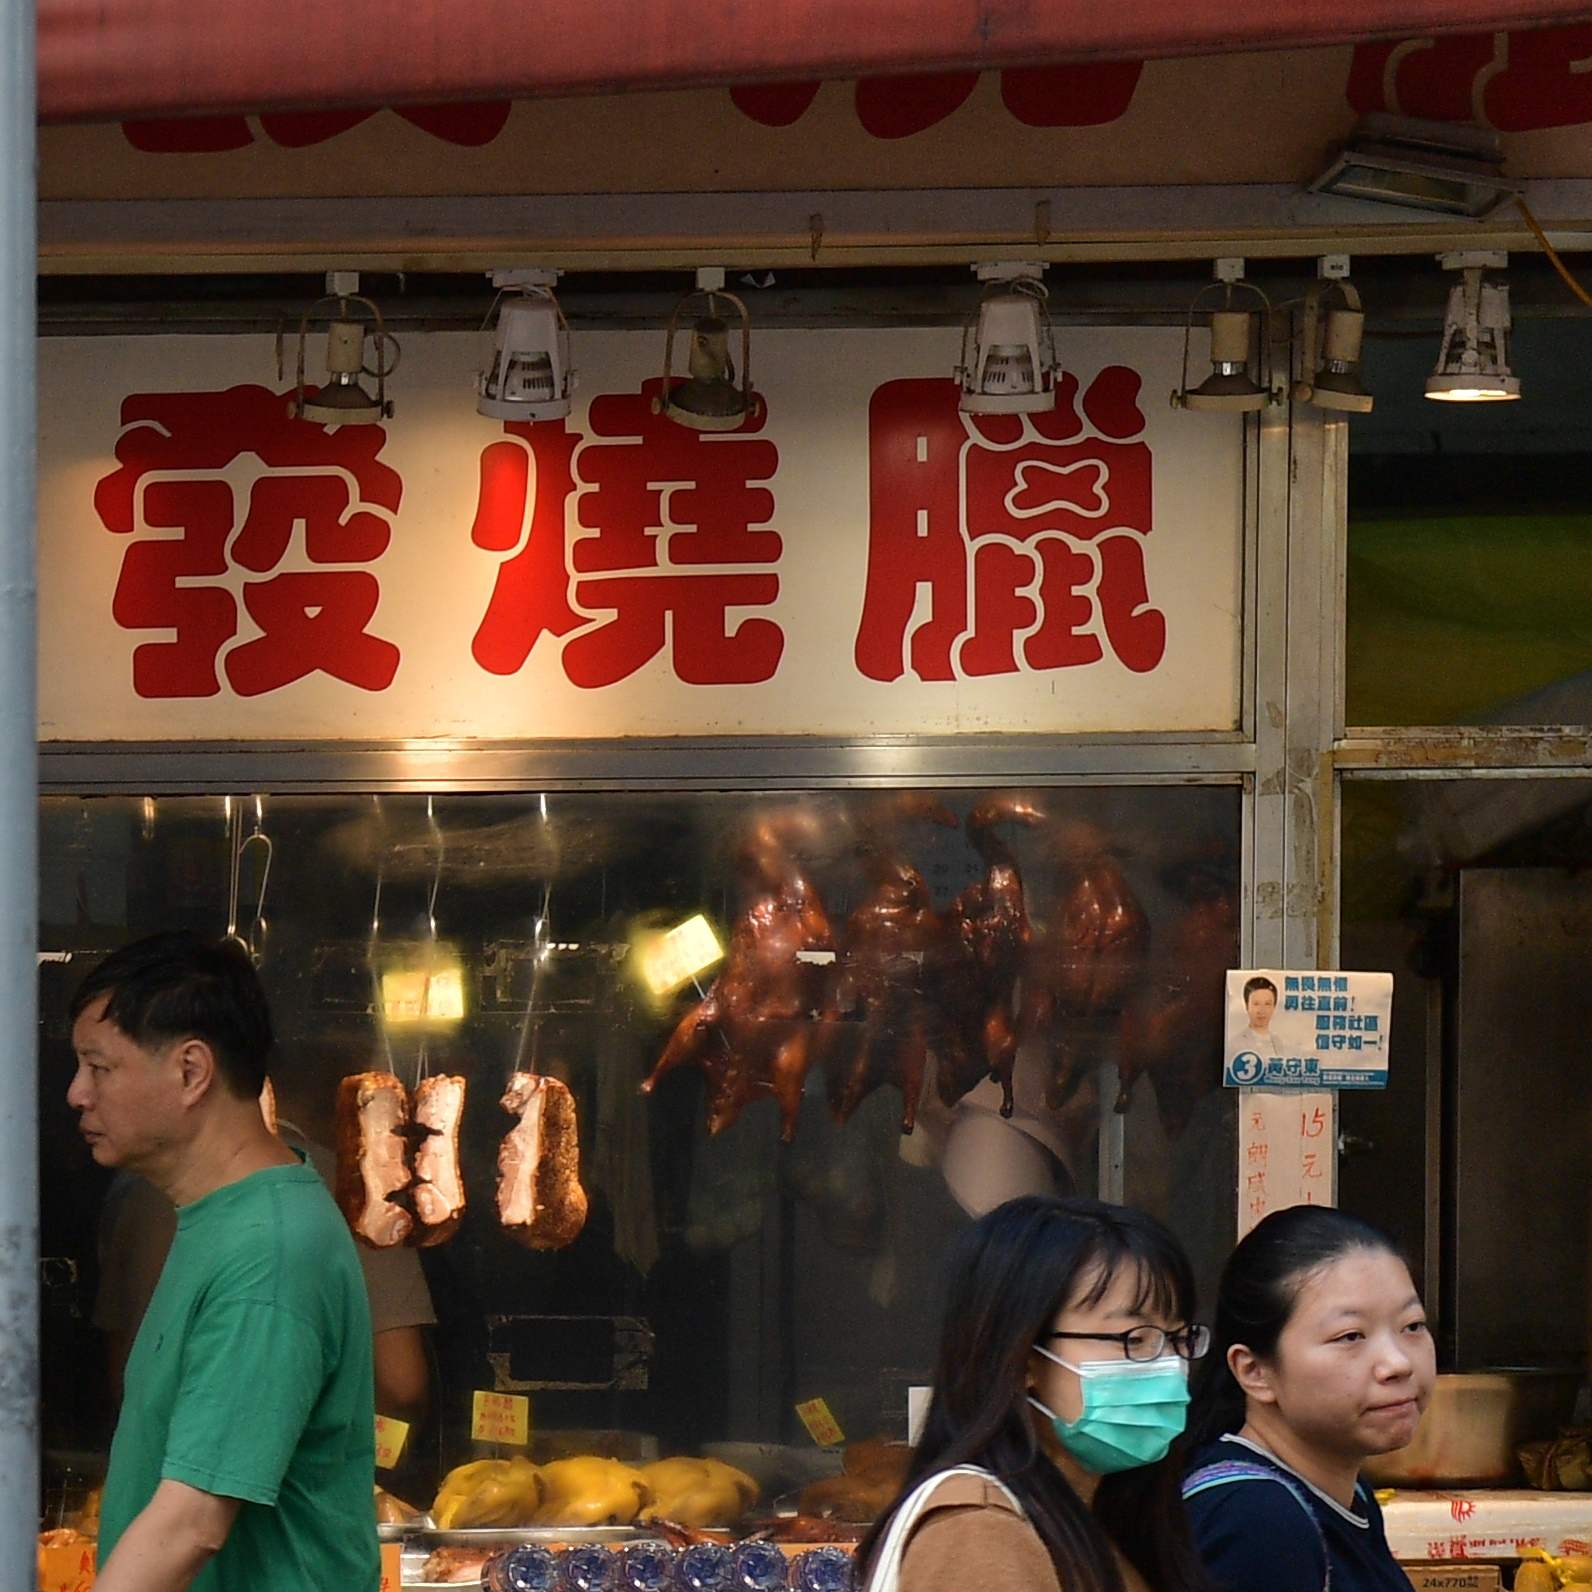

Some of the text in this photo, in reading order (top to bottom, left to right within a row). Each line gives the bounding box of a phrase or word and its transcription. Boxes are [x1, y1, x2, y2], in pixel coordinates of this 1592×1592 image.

[1315, 1015, 1378, 1031] 服務社區
[1315, 1034, 1383, 1051] 信守如一!
[1237, 1054, 1257, 1081] 3
